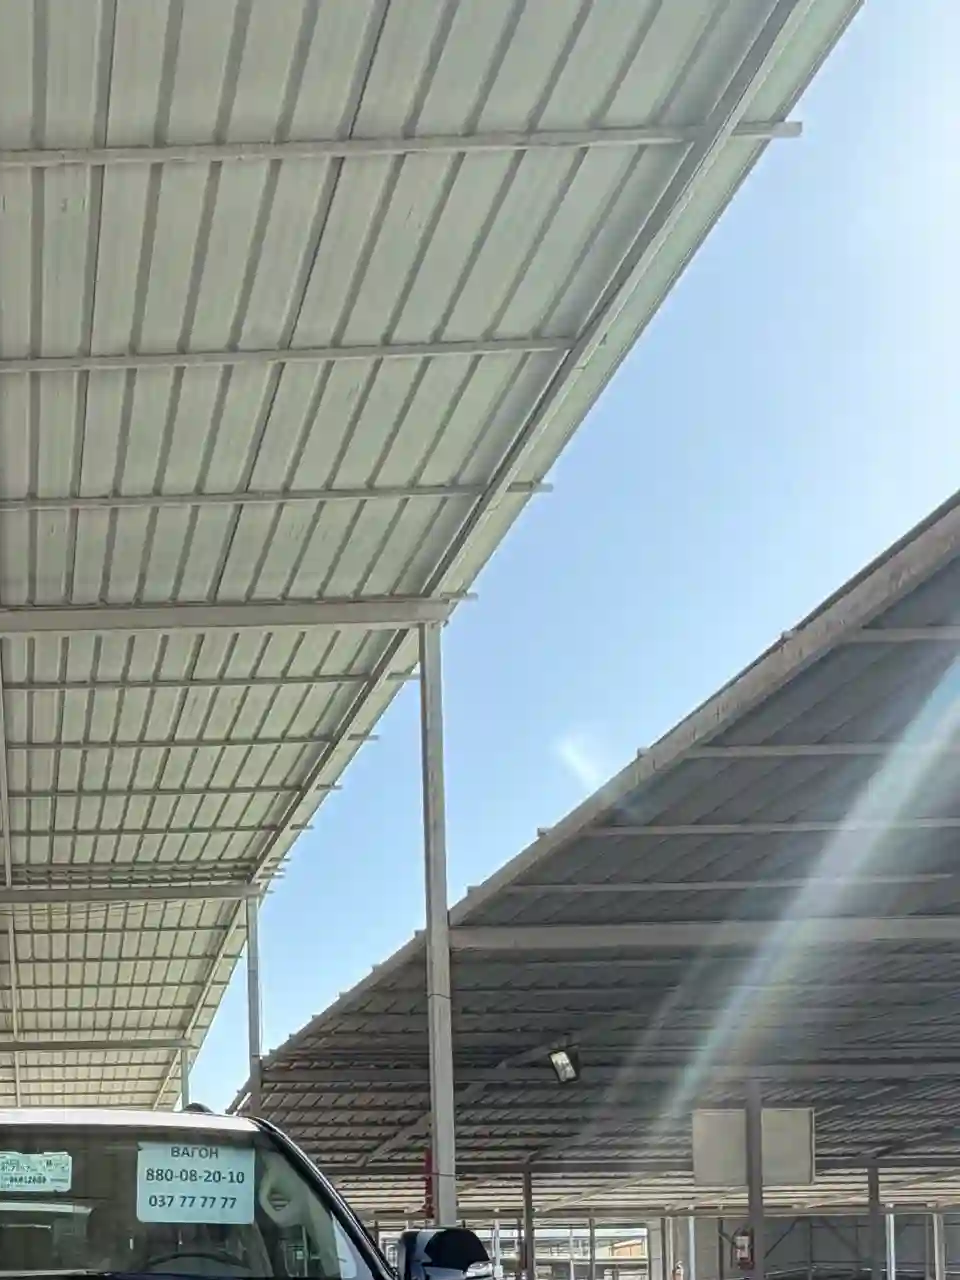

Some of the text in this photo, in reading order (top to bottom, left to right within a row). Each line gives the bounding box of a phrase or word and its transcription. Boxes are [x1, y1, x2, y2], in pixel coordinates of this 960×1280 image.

[170, 1146, 219, 1159] ВАГОН
[146, 1168, 245, 1184] 880-08-20-10
[148, 1195, 237, 1209] 037 77 77 77
